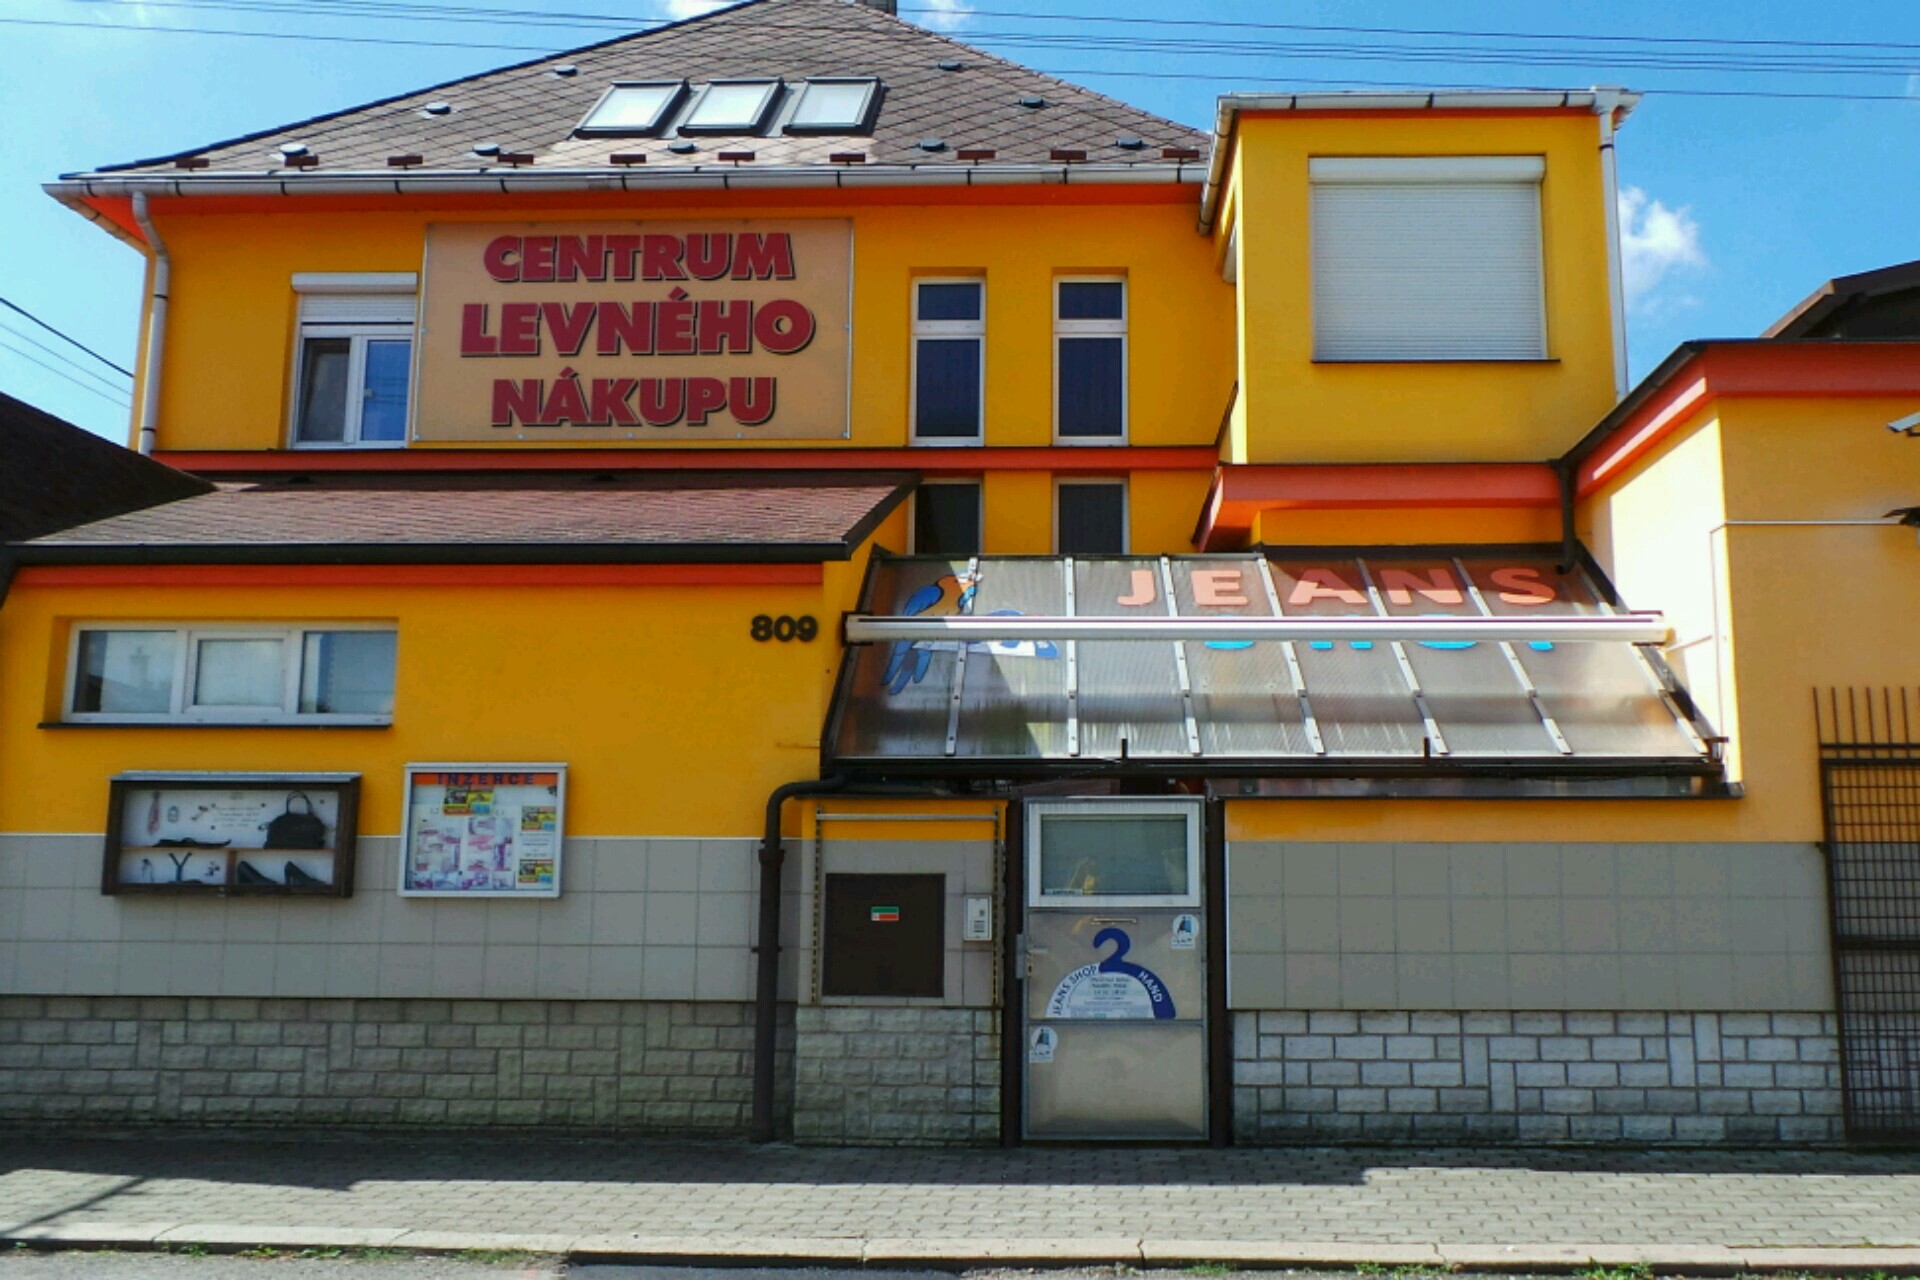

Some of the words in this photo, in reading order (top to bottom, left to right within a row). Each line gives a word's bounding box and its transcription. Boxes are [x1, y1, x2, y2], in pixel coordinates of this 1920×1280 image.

[483, 233, 796, 282] CENTRUM
[460, 286, 816, 357] LEVNÉHO
[491, 366, 776, 427] NÁKUPU
[1117, 568, 1556, 606] JEANS
[751, 614, 819, 643] 809
[438, 772, 535, 785] INZERCE
[1052, 984, 1071, 1016] JEANS
[1069, 965, 1098, 985] SHOP
[1138, 971, 1163, 1003] HAND
